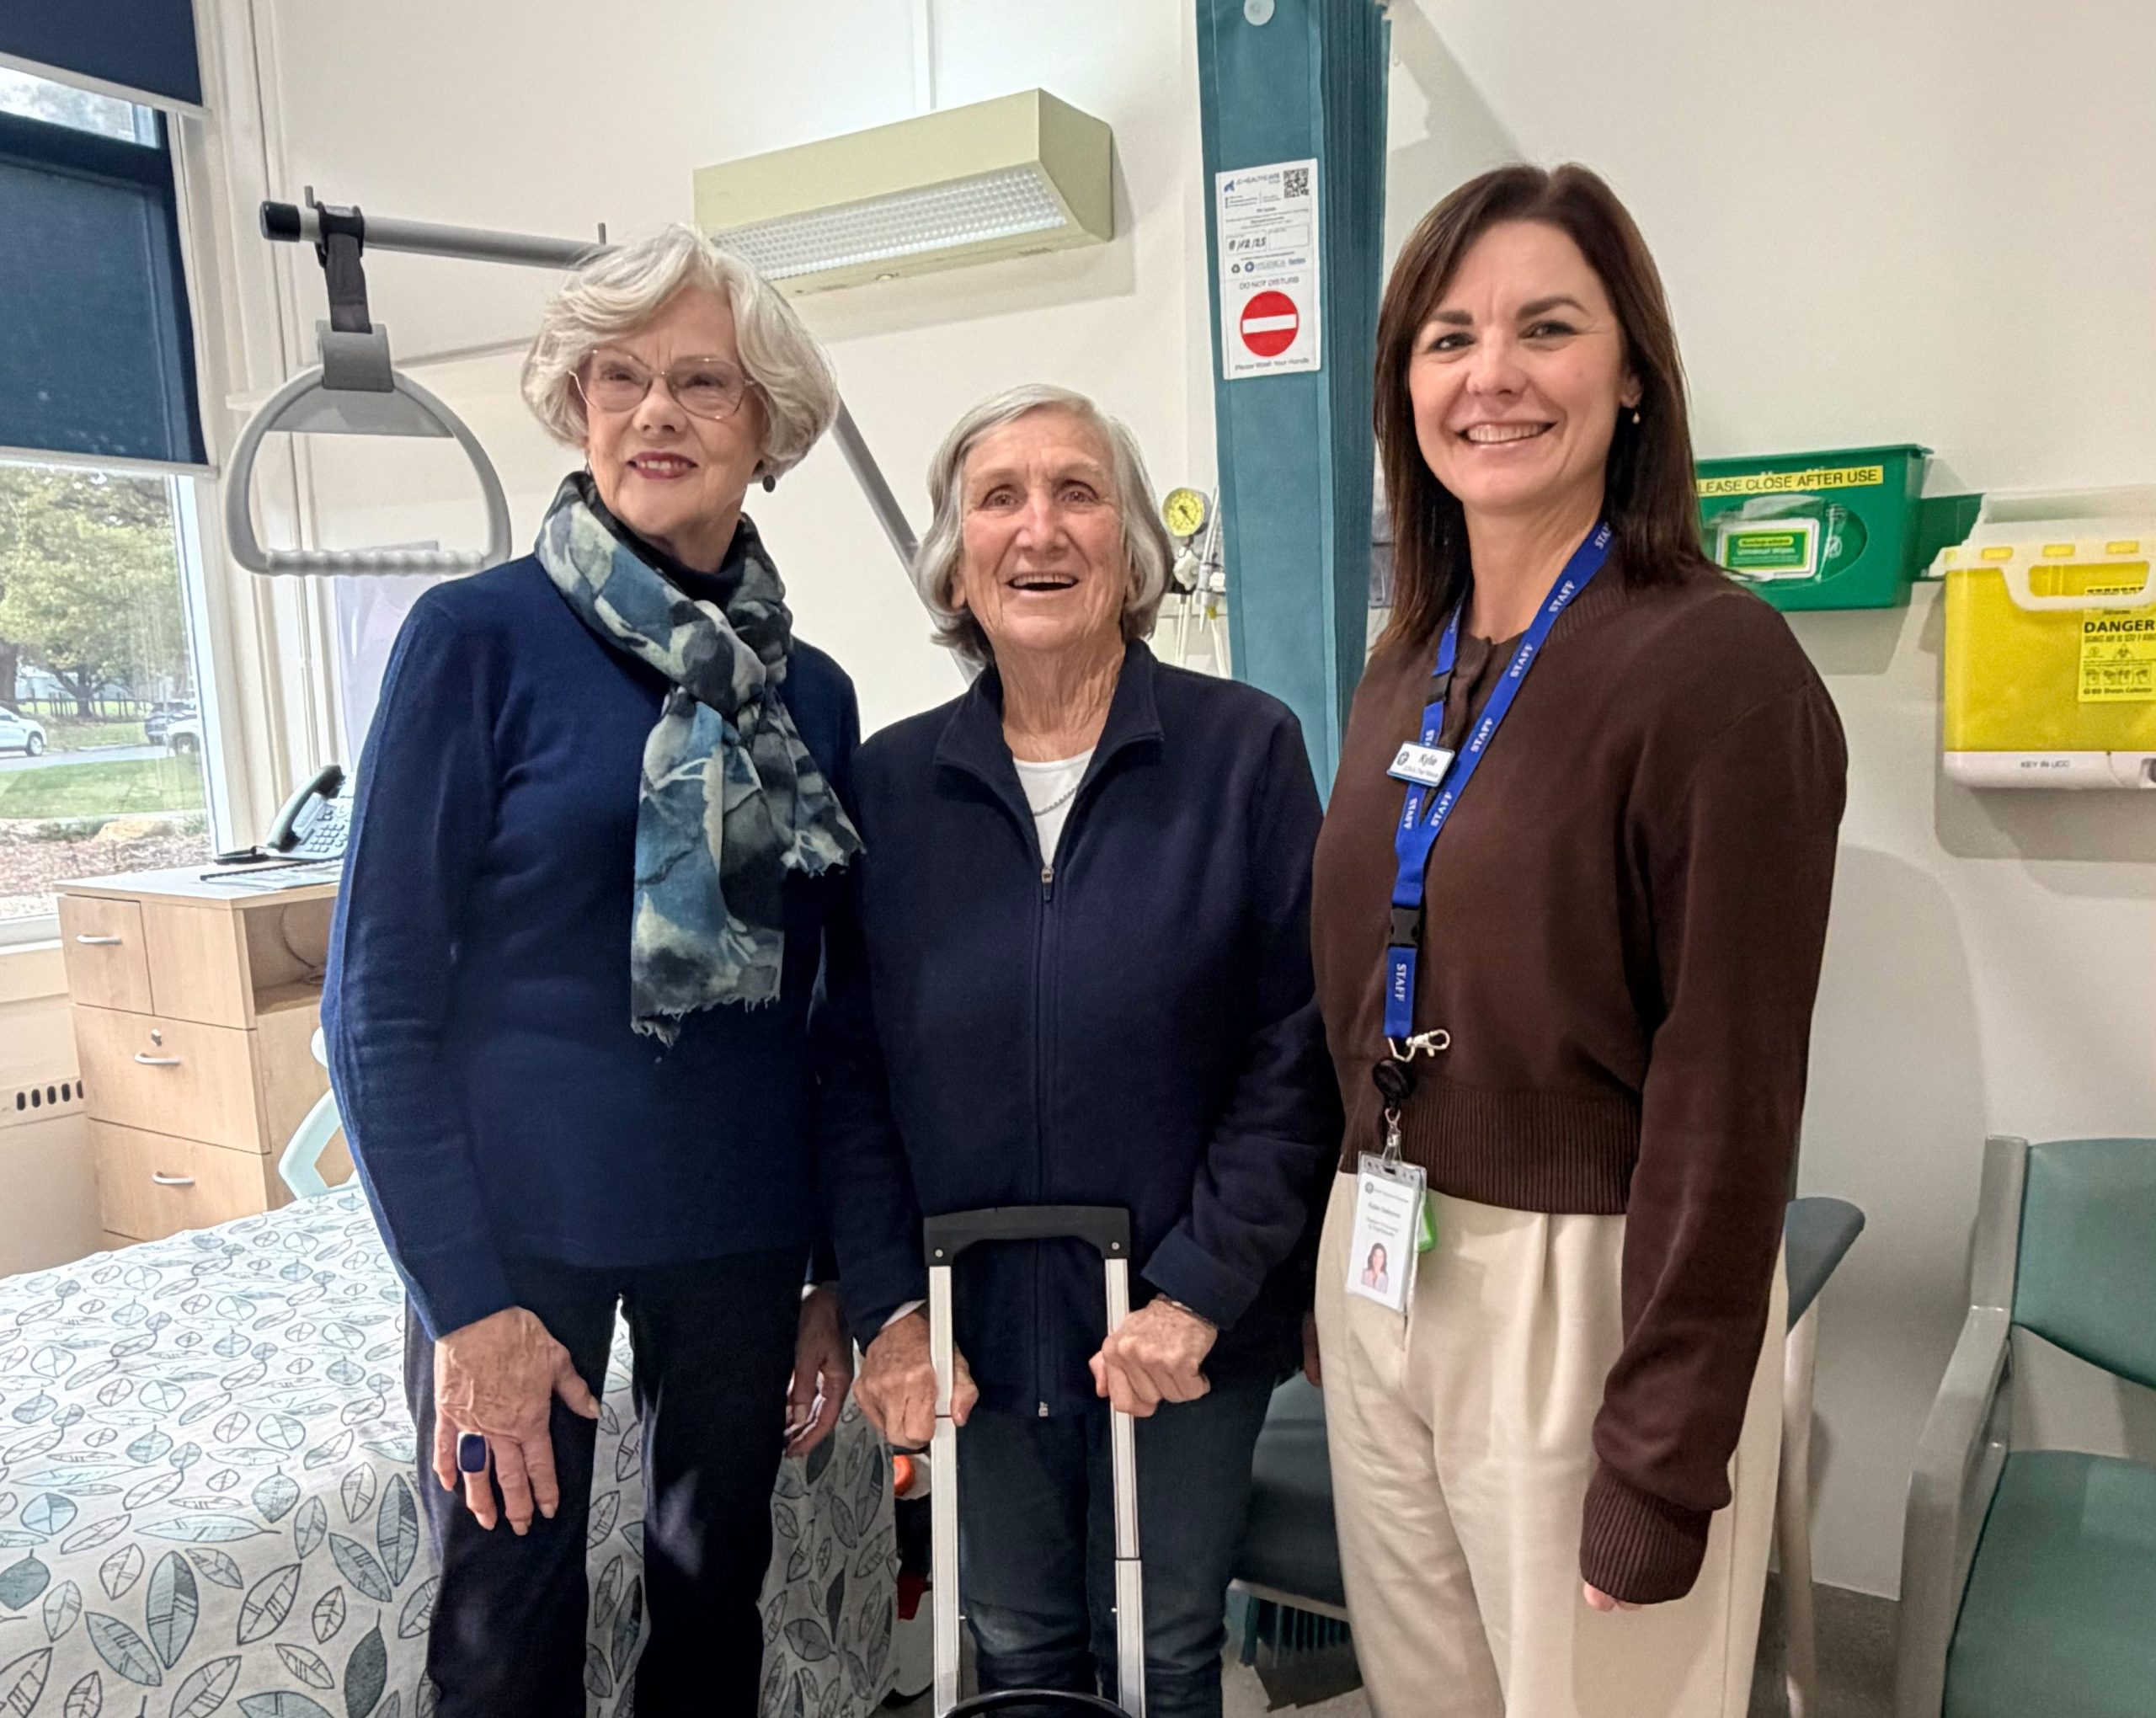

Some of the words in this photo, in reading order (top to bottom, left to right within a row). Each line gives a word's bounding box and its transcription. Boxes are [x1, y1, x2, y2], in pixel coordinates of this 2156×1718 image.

[1240, 280, 1251, 290] DO
[1251, 278, 1267, 288] NOT
[1268, 276, 1299, 287] DISTURB
[1698, 480, 1742, 494] LEASE
[1745, 475, 1792, 490] CLOSE
[1796, 472, 1843, 487] AFTER
[1847, 468, 1878, 483] USE
[1548, 579, 1576, 613] STAFF
[2084, 619, 2155, 633] DANGER
[1510, 643, 1534, 678] STAFF
[1470, 718, 1494, 753] STAFF
[1430, 791, 1453, 828] STAFF
[1395, 963, 1407, 1003] STAFF
